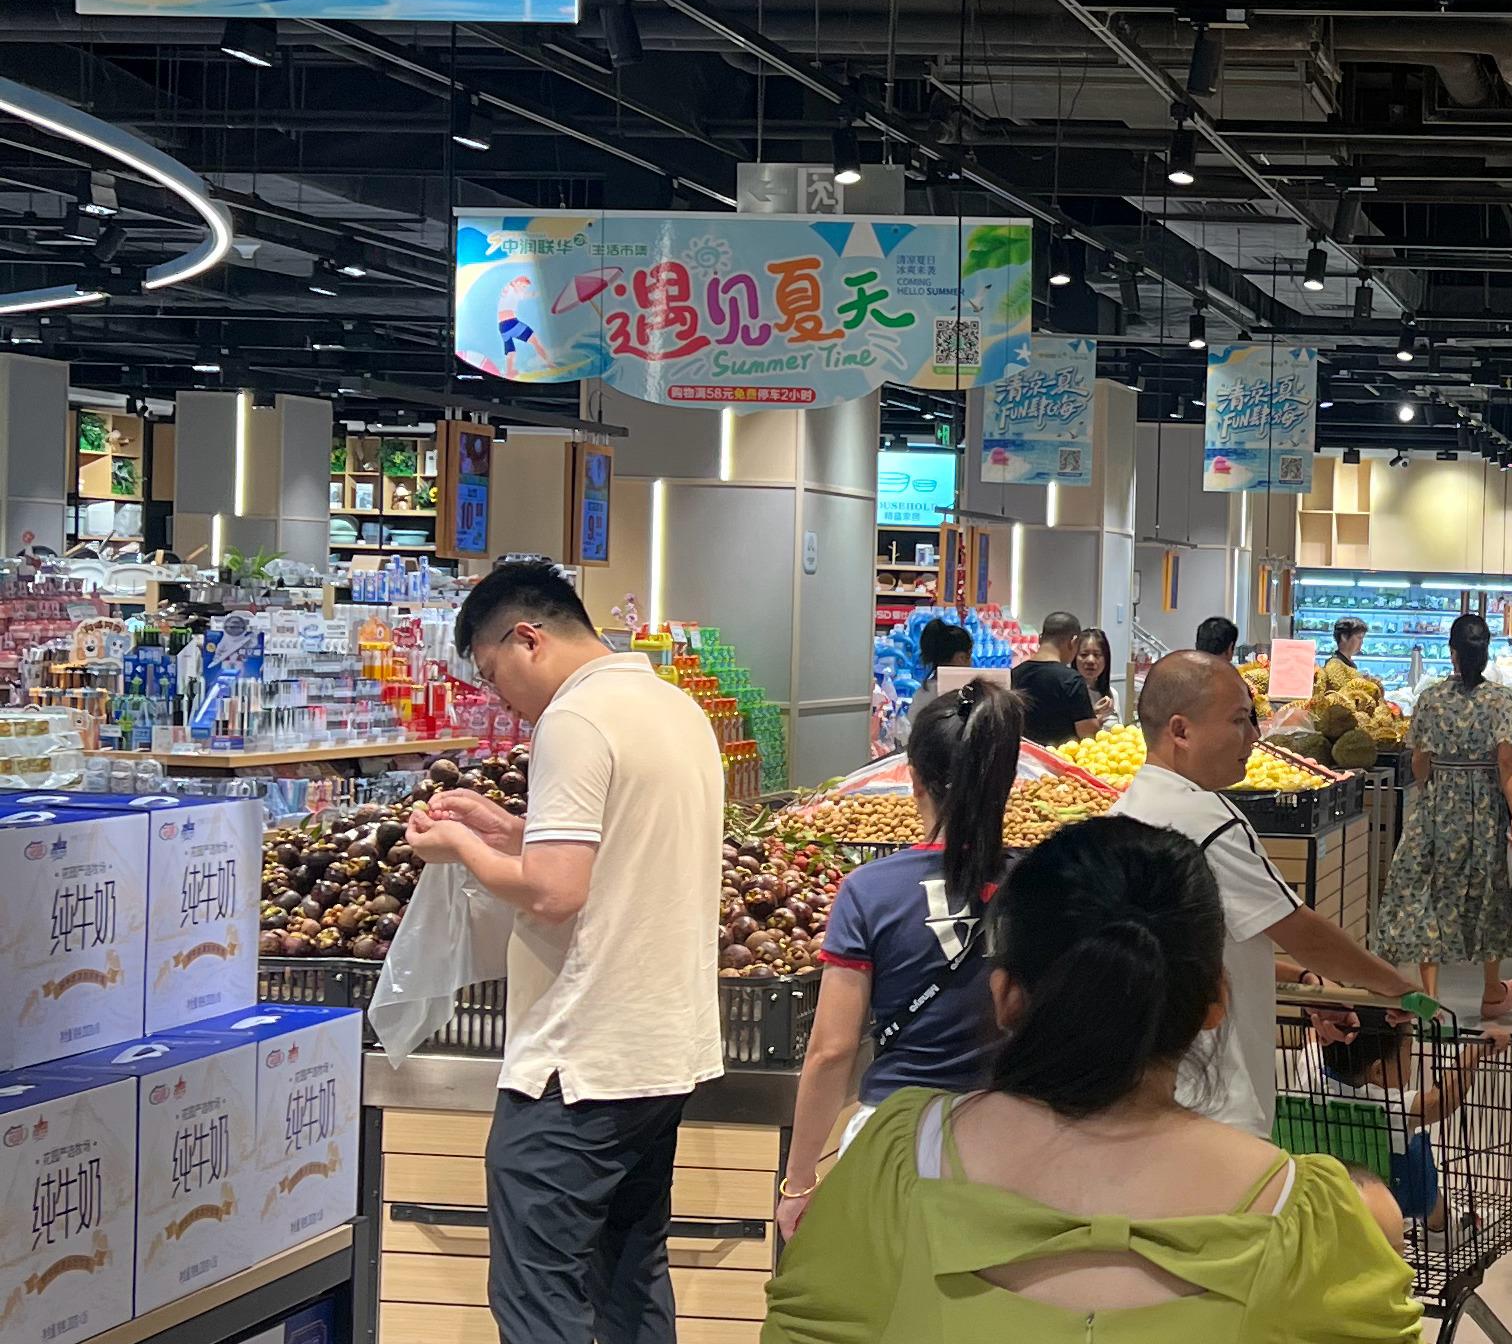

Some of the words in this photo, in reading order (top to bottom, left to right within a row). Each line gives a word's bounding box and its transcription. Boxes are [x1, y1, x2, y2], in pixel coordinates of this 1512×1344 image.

[502, 238, 573, 256] 中润联华
[592, 244, 648, 257] 生活市集
[603, 257, 916, 361] 遇见夏天
[896, 287, 925, 296] HELLO
[926, 287, 966, 297] SUMMER
[670, 386, 815, 403] 购物满58元免费停车2小时
[711, 350, 812, 378] Summer
[818, 345, 877, 367] Time
[995, 367, 1090, 404] 清凉一夏
[50, 880, 116, 956] 纯牛奶
[180, 859, 236, 929] 纯牛奶
[284, 1078, 336, 1155] 纯牛奶
[171, 1115, 229, 1199] 纯牛奶
[31, 1158, 102, 1252] 纯牛奶
